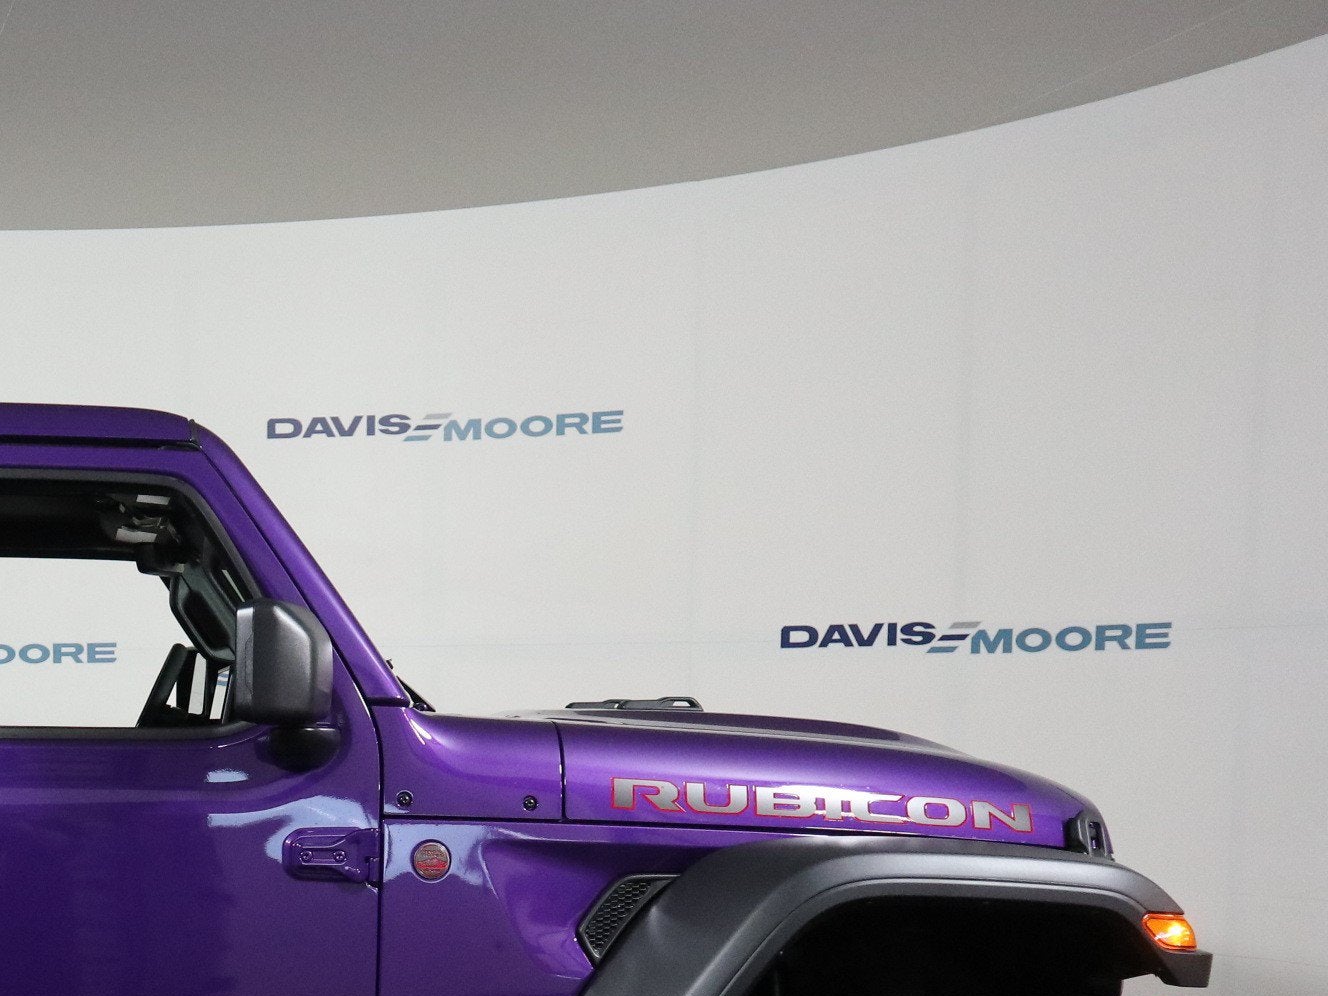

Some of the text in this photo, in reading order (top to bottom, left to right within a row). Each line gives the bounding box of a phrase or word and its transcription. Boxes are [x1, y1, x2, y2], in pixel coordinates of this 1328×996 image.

[266, 410, 624, 442] DAVIS MOORE
[780, 621, 1173, 655] DAVIS MOORE
[610, 776, 1035, 833] RUBICON
